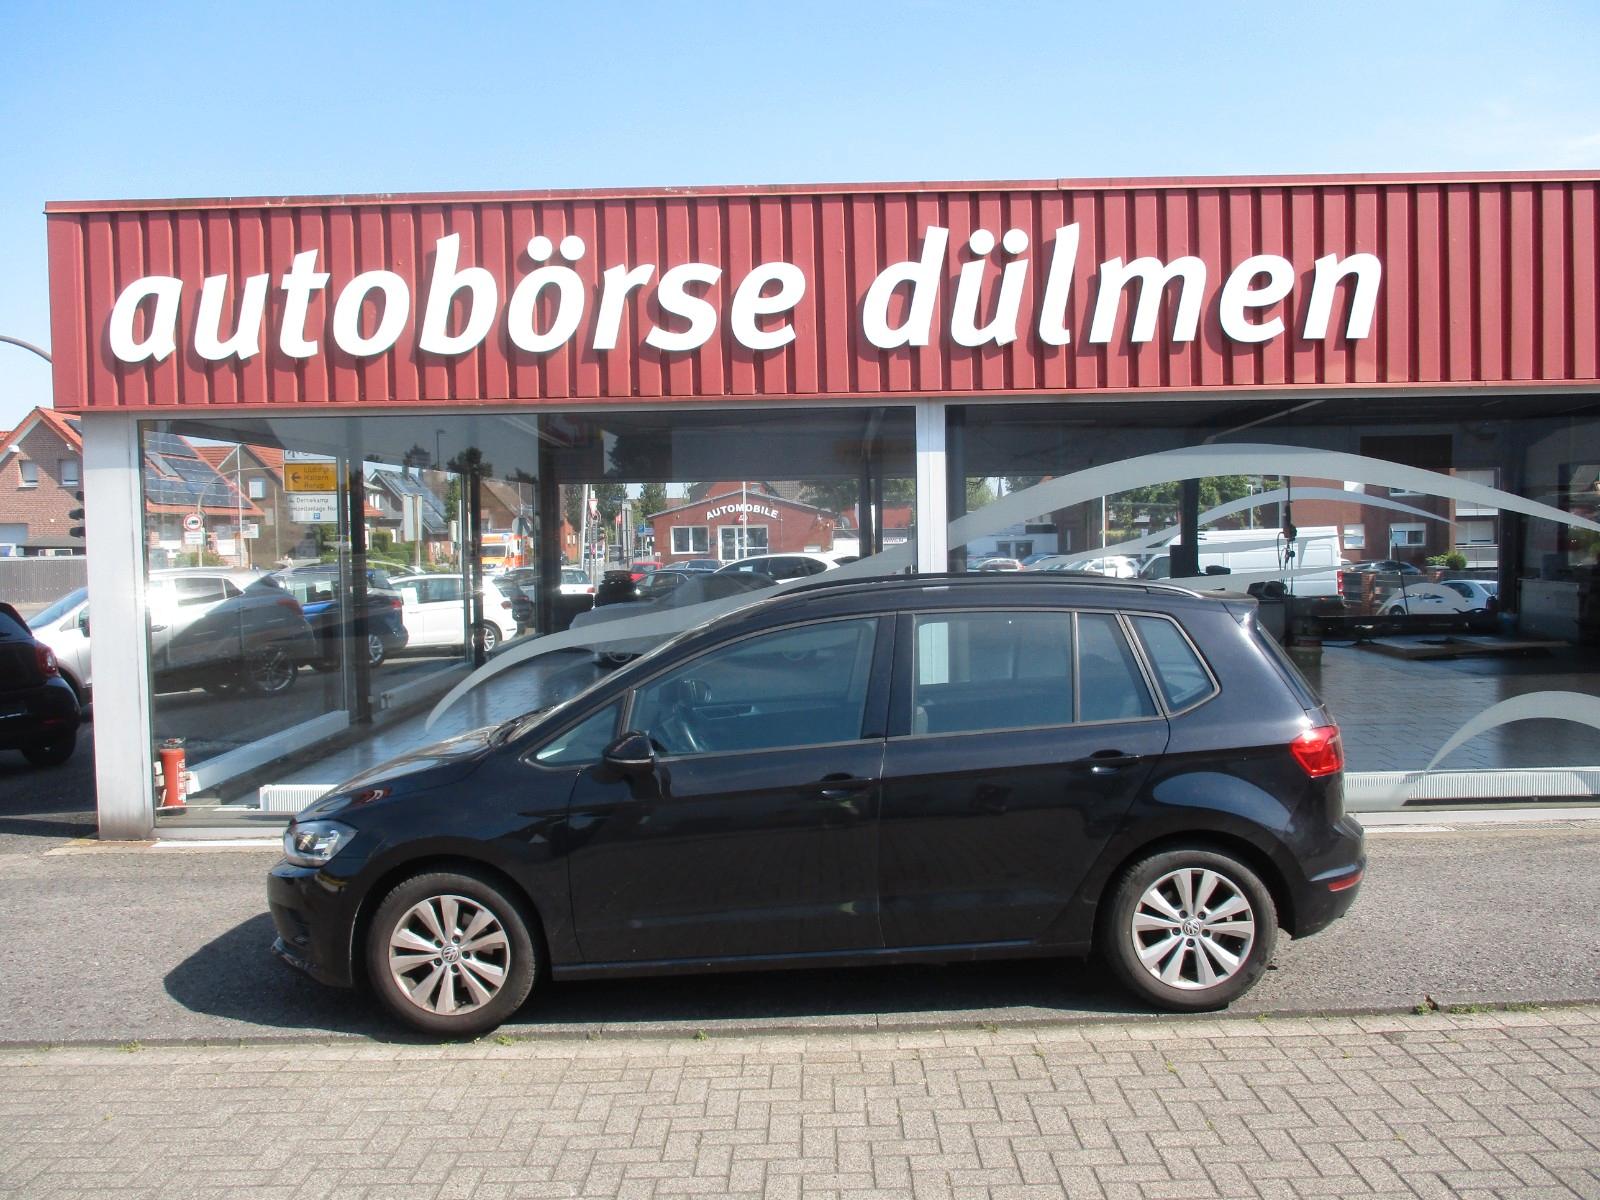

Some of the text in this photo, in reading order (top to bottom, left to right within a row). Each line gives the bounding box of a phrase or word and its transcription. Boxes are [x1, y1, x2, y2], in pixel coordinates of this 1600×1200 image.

[109, 222, 1382, 363] autobörse dülmen
[706, 503, 779, 521] AUTOMOBILE
